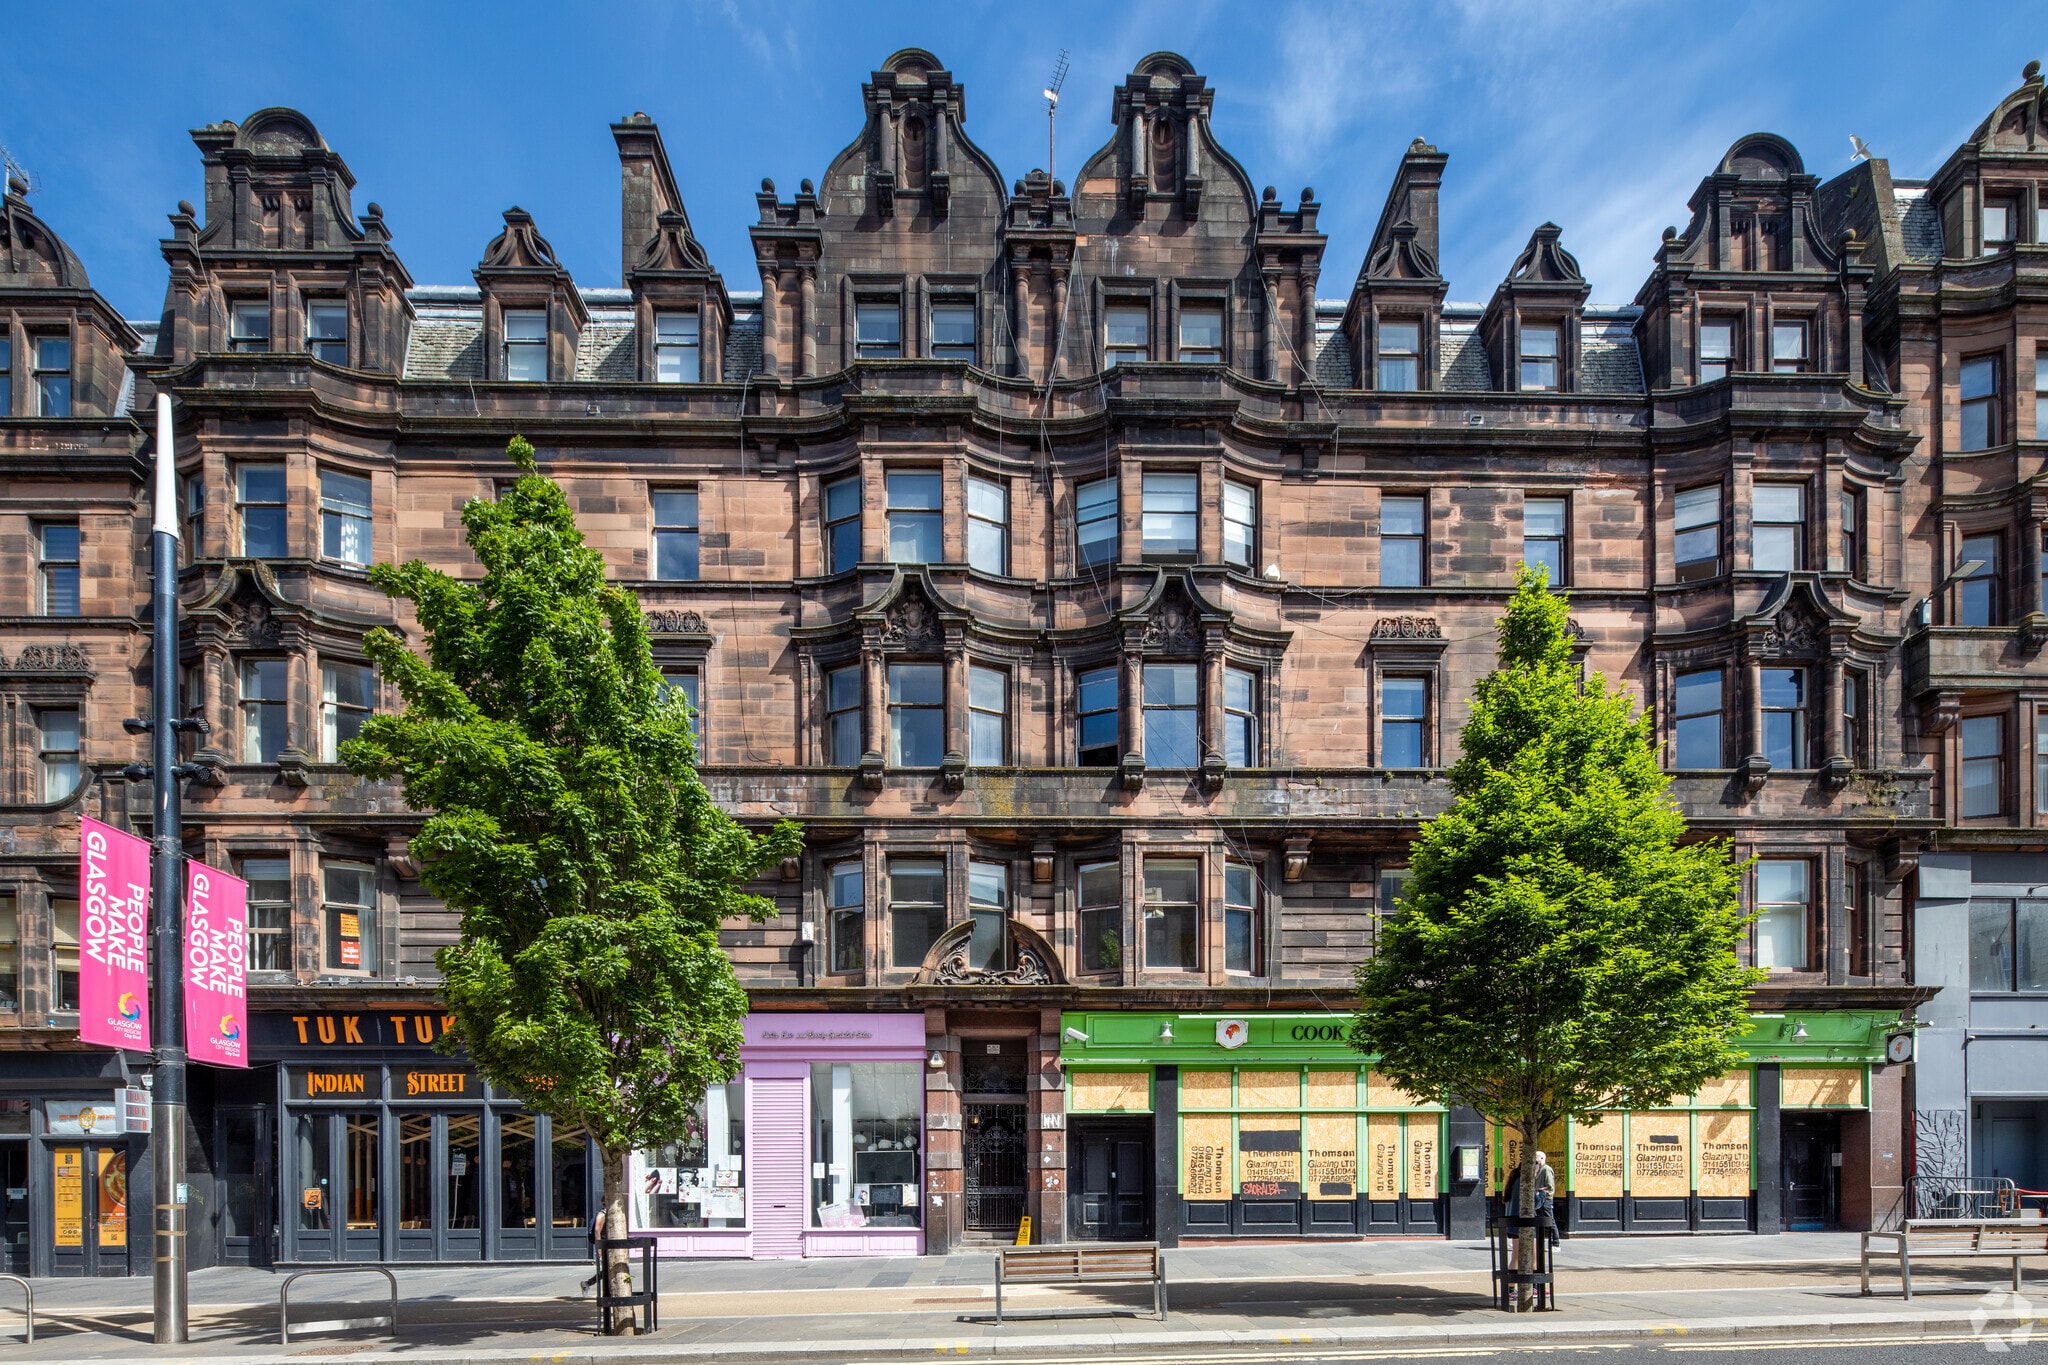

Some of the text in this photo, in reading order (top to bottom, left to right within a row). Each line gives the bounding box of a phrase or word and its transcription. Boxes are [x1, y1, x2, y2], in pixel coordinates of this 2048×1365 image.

[86, 831, 107, 964] GLASGOW
[107, 894, 126, 969] MAKE
[127, 882, 145, 974] PEOPLE
[189, 873, 210, 990] GLASGOW
[209, 928, 227, 994] MAKE
[227, 917, 243, 998] PEOPLE
[107, 1017, 142, 1030] GLASGOW
[124, 1027, 142, 1035] REGION
[292, 1016, 364, 1044] TUK
[1292, 1025, 1344, 1041] COOK
[210, 1037, 241, 1048] GLASGOW
[307, 1071, 466, 1097] INDIAN STREET
[127, 1092, 146, 1103] TUK
[127, 1106, 146, 1117] TUK
[1308, 1149, 1355, 1157] Thomson
[1413, 1140, 1422, 1172] Glazing
[1509, 1140, 1517, 1170] Glazing
[1575, 1142, 1622, 1151] Thomson
[1636, 1143, 1683, 1151] Thomson
[1702, 1142, 1748, 1150] Thomson
[1702, 1152, 1733, 1161] Glazing
[1246, 1160, 1294, 1169] Glazing LTD
[1308, 1159, 1356, 1168] Glazing LTD
[1376, 1143, 1385, 1192] Glazing LTD
[1387, 1144, 1396, 1191] Thomson
[1424, 1140, 1433, 1188] Thomson
[1575, 1152, 1607, 1162] Glazing
[1636, 1153, 1683, 1163] Glazing LTD
[1204, 1145, 1214, 1194] Glazing LTD
[1215, 1146, 1224, 1193] Thomson
